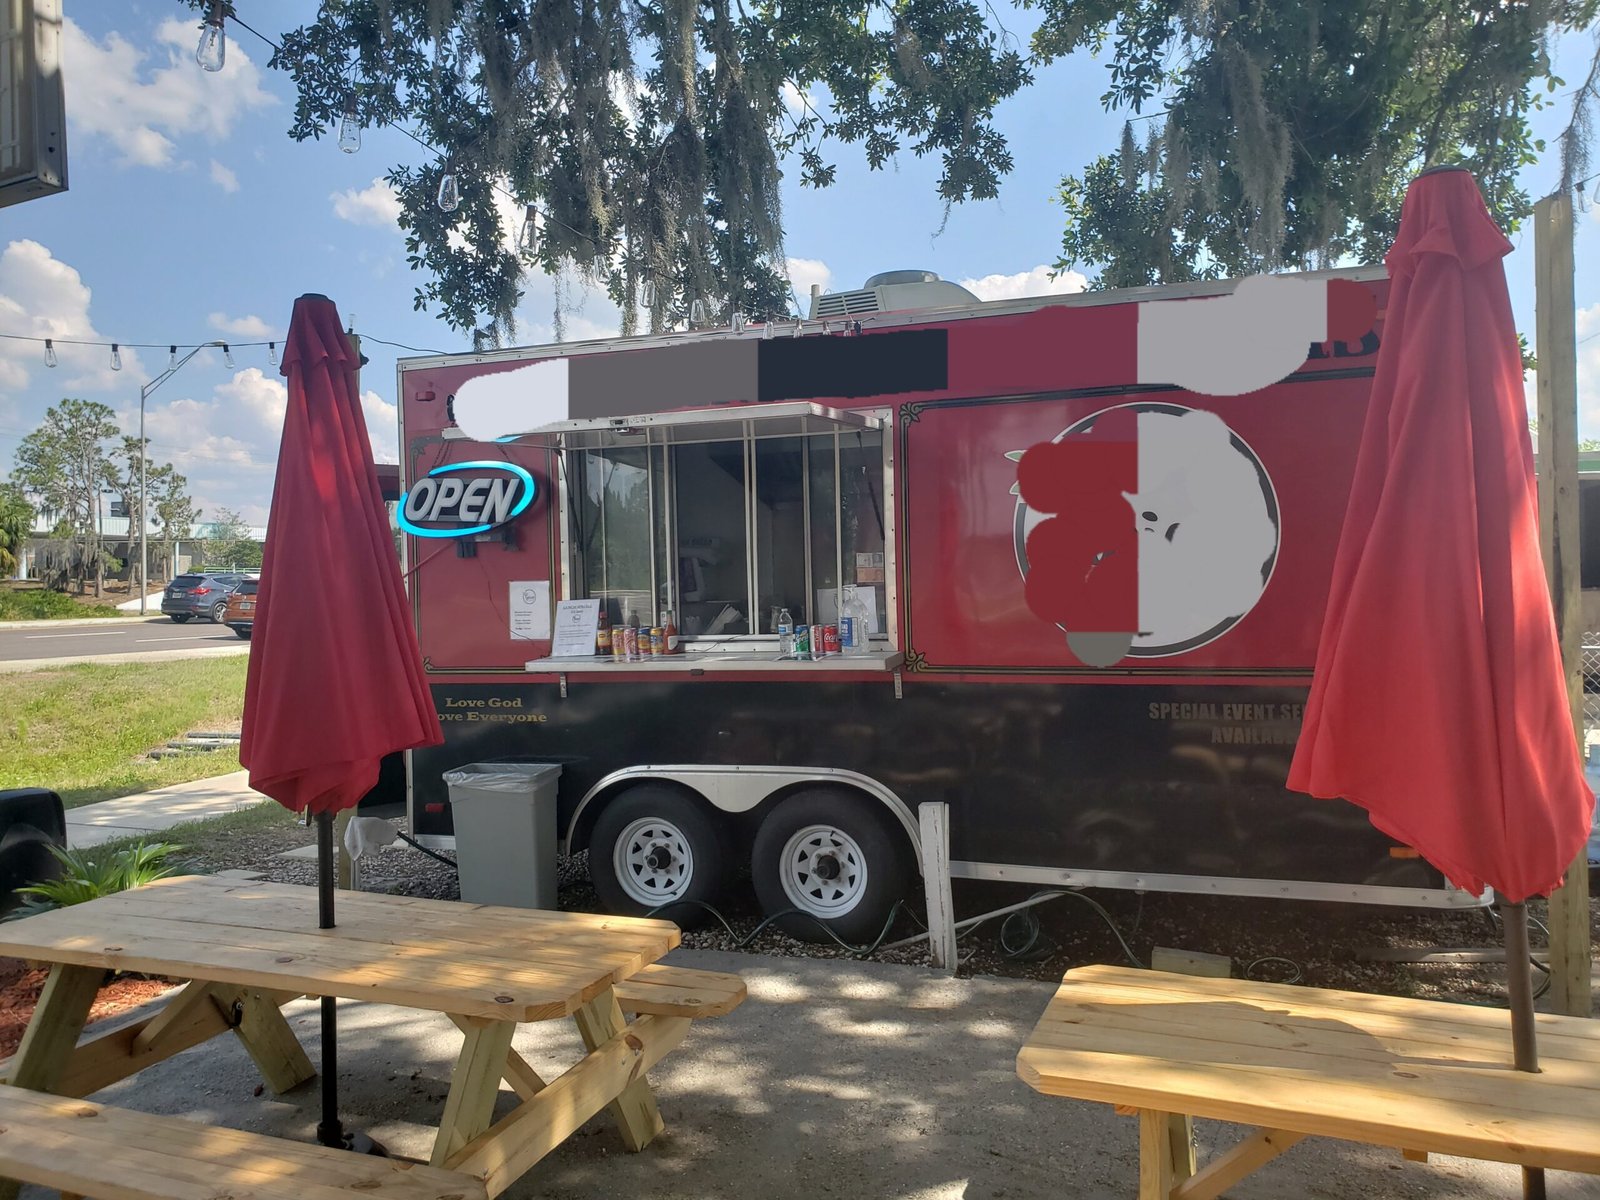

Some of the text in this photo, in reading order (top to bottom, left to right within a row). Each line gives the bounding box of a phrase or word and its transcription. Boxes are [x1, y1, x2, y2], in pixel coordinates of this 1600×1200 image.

[405, 478, 520, 523] OPEN
[445, 697, 523, 708] Love God
[437, 711, 548, 724] ove Everyone
[1149, 703, 1218, 720] SPECIAL
[1222, 703, 1275, 721] EVENT
